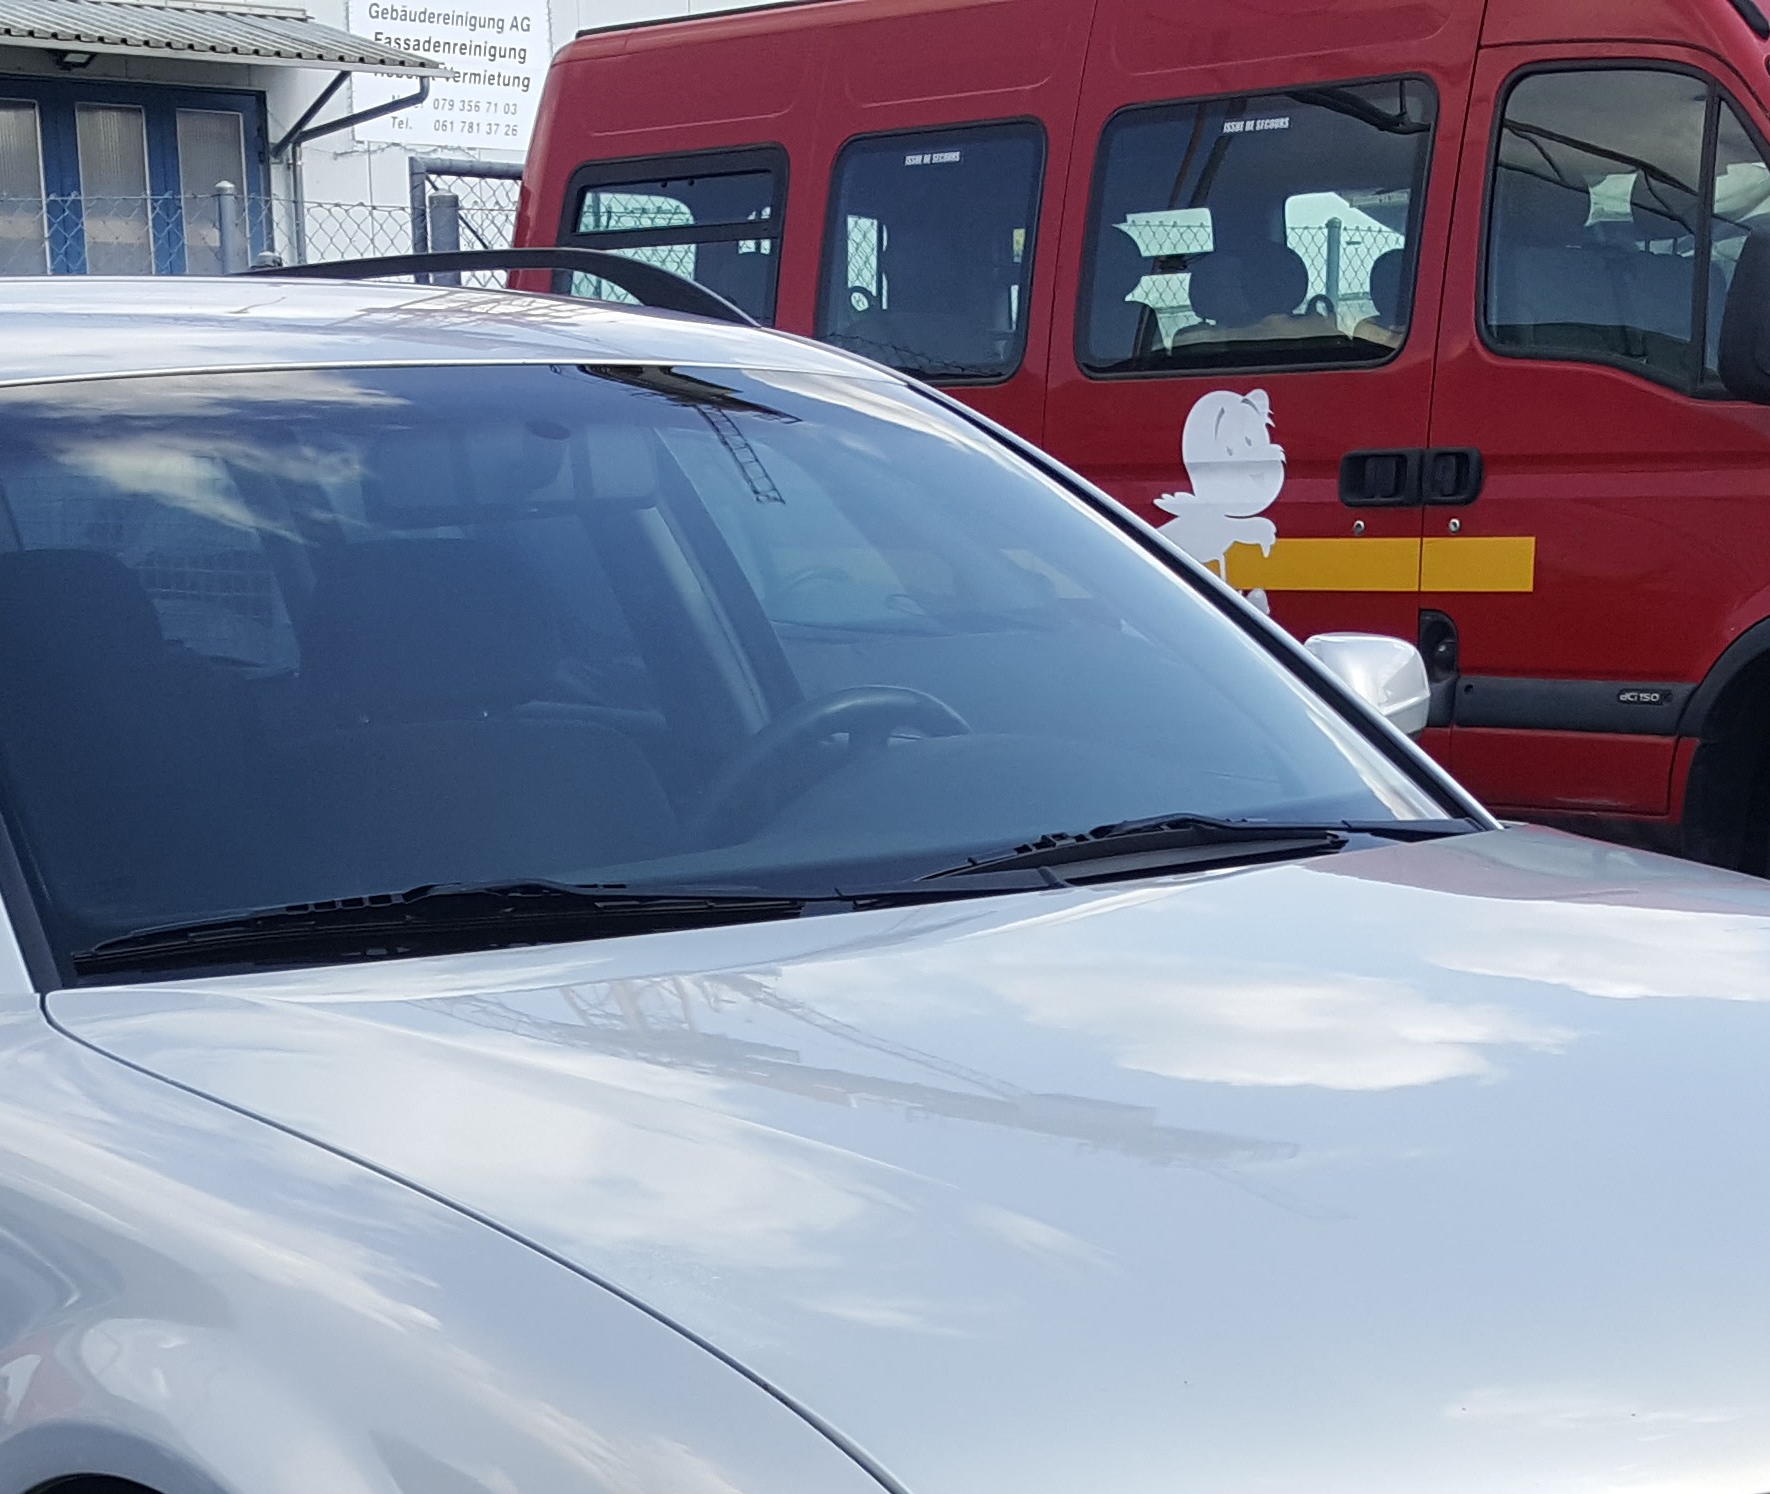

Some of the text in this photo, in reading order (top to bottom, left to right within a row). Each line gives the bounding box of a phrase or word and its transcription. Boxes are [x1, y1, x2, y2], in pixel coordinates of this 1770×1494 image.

[368, 3, 531, 34] Gebäudereinigung AG
[374, 31, 528, 65] Fassadenreinigung
[433, 98, 455, 112] 079
[459, 99, 481, 113] 356
[485, 101, 499, 114] 71
[503, 103, 518, 116] 03
[391, 116, 519, 137] Tel. 061 781 37 26
